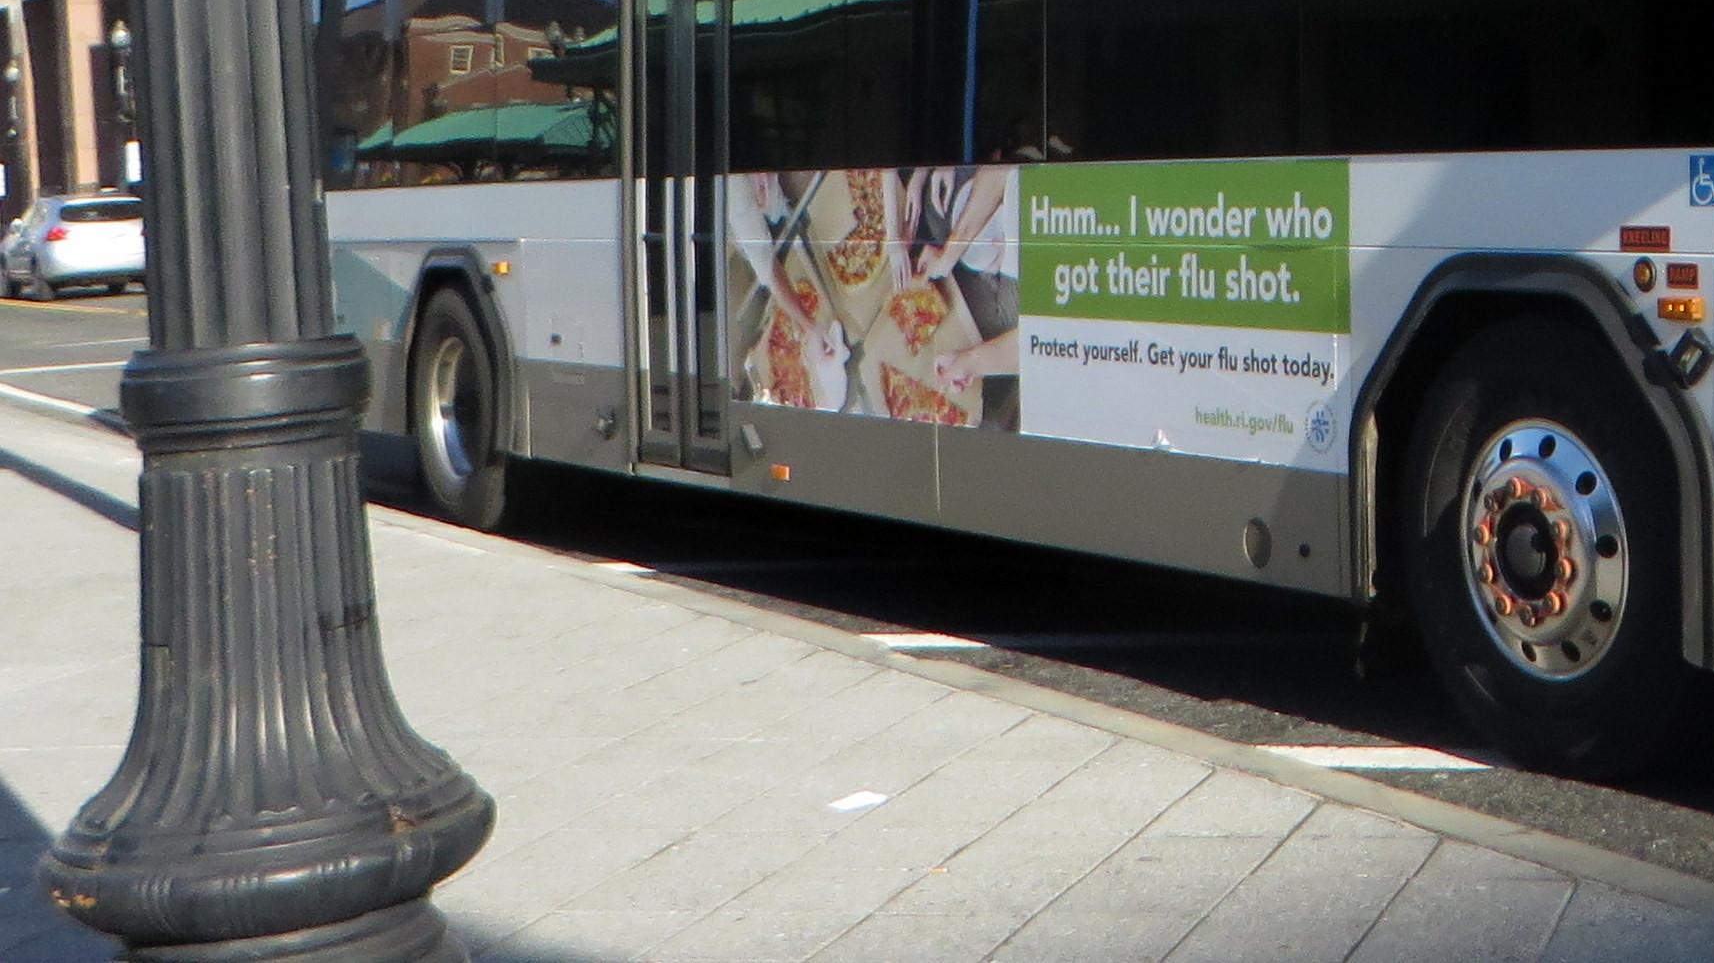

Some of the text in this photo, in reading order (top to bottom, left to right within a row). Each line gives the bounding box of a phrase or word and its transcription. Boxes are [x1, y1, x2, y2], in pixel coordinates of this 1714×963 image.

[1031, 192, 1332, 239] Hmm... I wonder who
[1055, 252, 1299, 304] got their flu shot.
[1031, 335, 1334, 386] Protect yourself. Get your flu shot today.
[1196, 406, 1293, 435] health.ri.gov/flu
